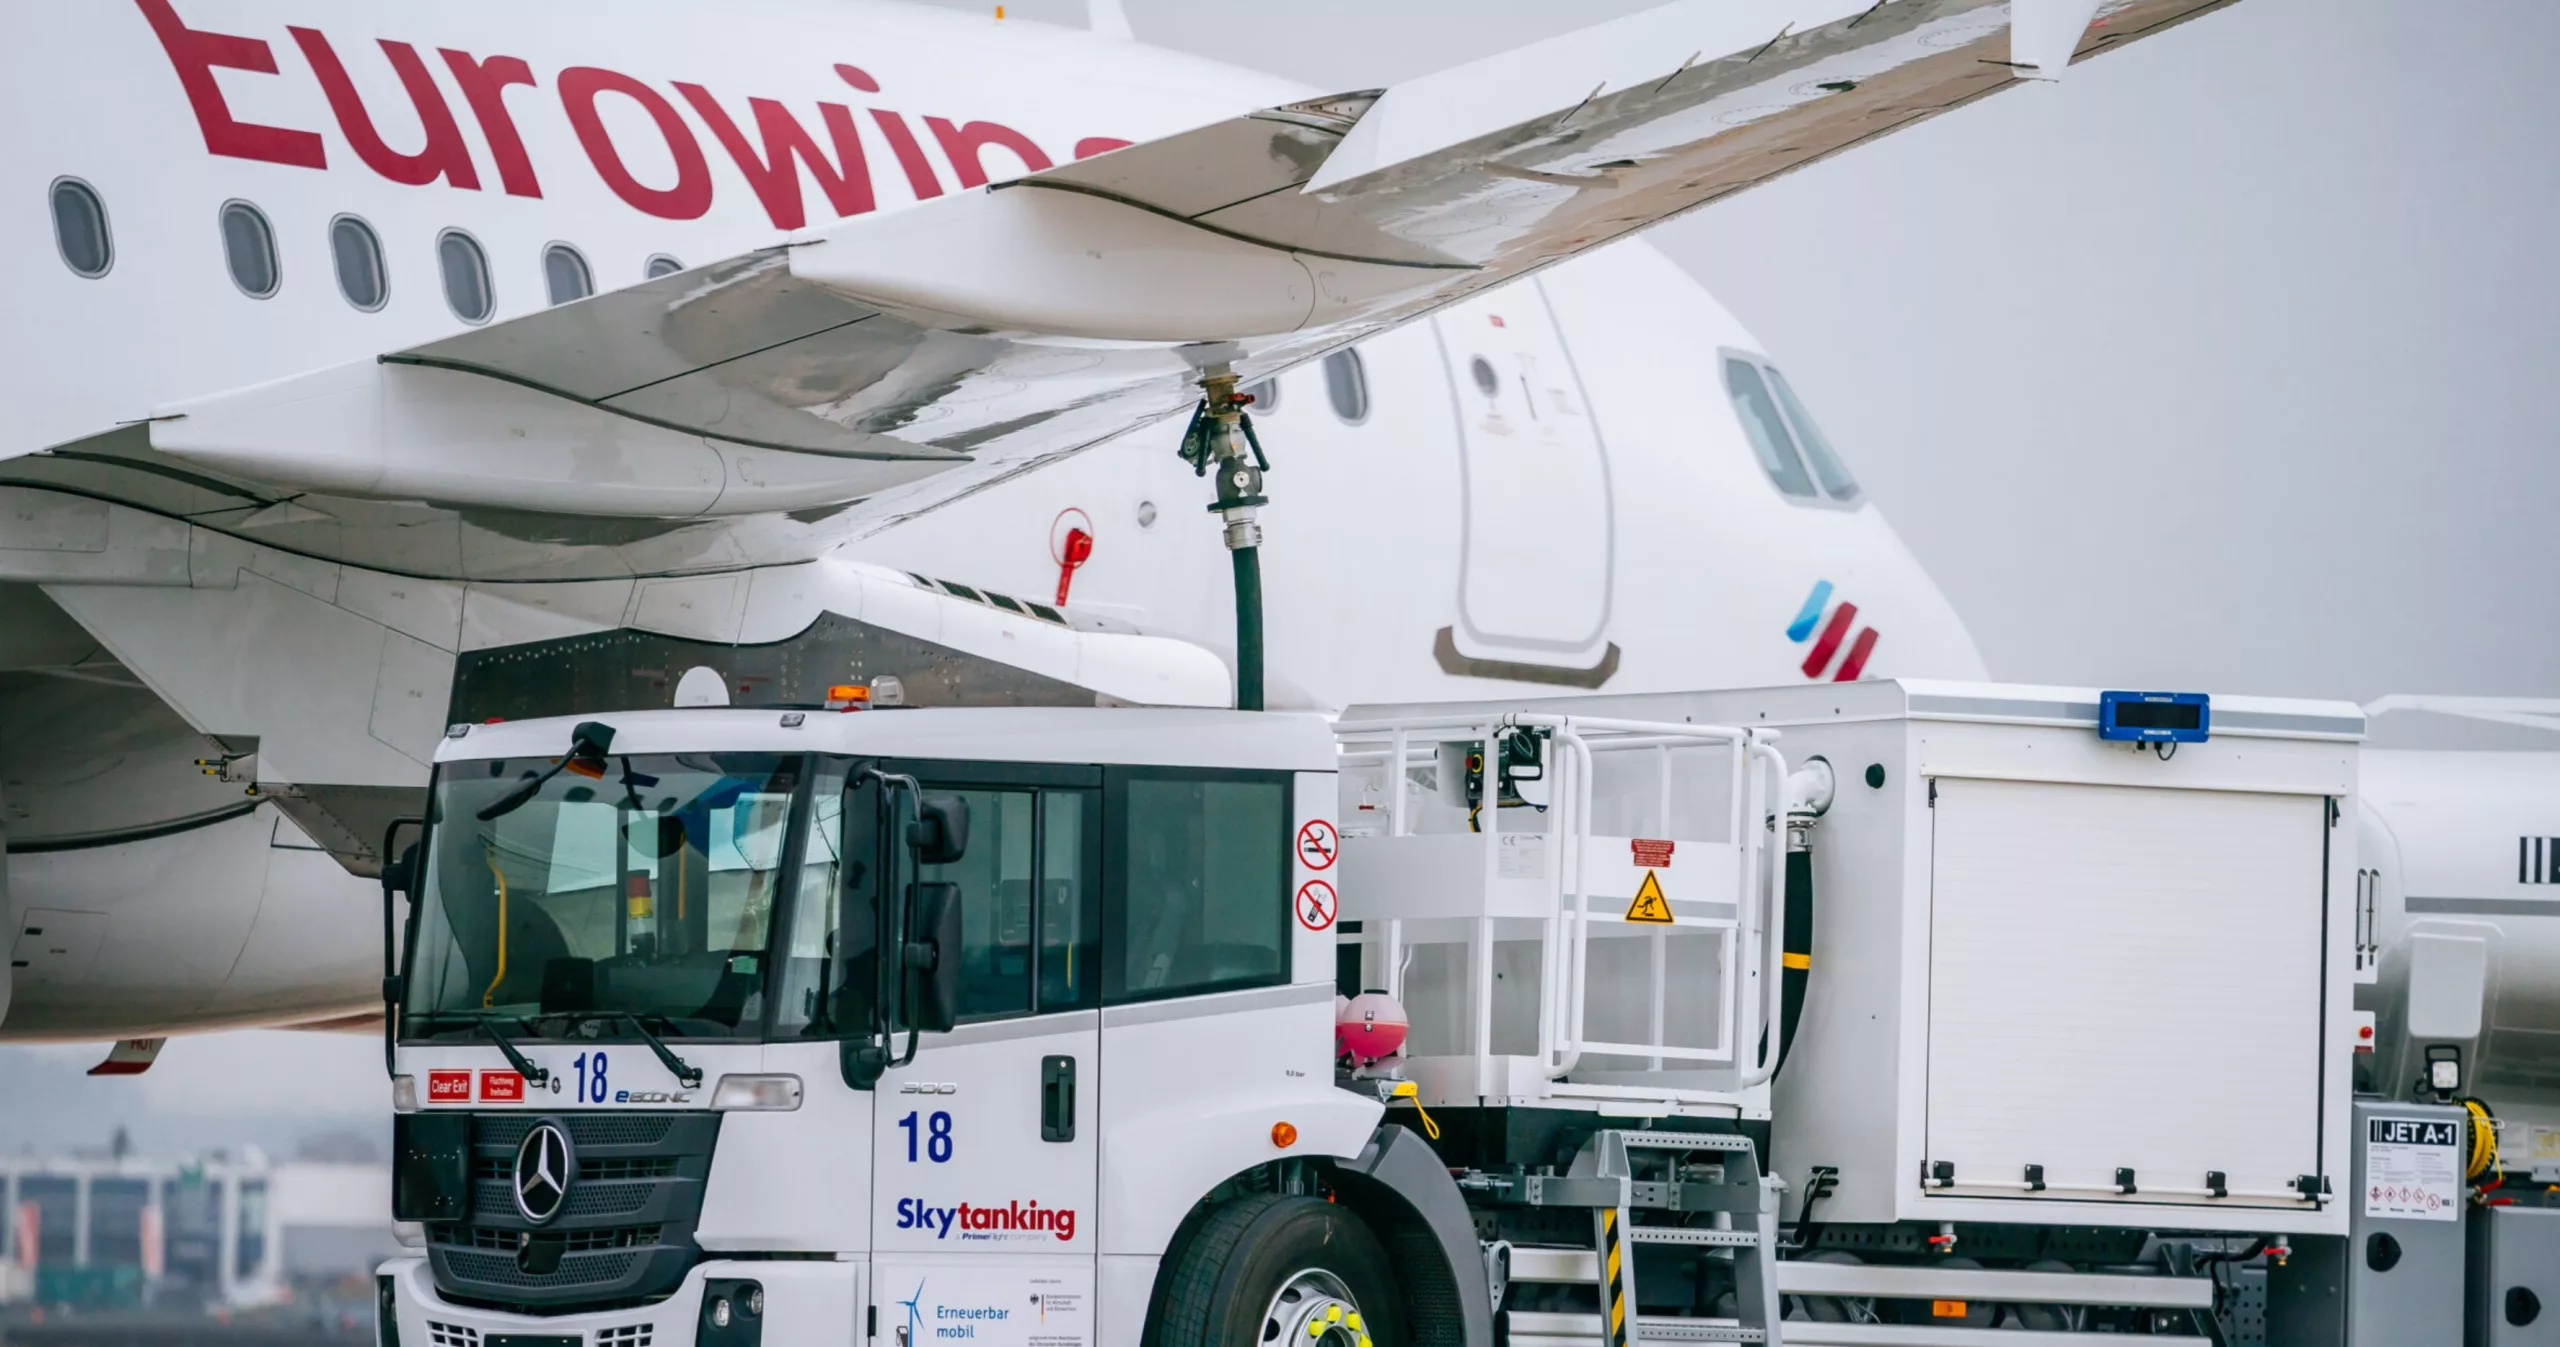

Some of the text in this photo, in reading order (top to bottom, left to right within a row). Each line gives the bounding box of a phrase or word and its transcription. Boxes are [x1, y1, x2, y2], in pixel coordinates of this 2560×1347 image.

[134, 0, 1136, 230] Eurowin
[431, 1079, 468, 1094] Clear Exit
[573, 1051, 607, 1103] 18
[900, 1081, 957, 1095] 300
[898, 1110, 953, 1163] 18
[2385, 1122, 2453, 1144] JET A-1
[896, 1197, 1076, 1241] Skytanking
[936, 1305, 1010, 1320] Erneuerbar
[936, 1325, 975, 1338] mobil
